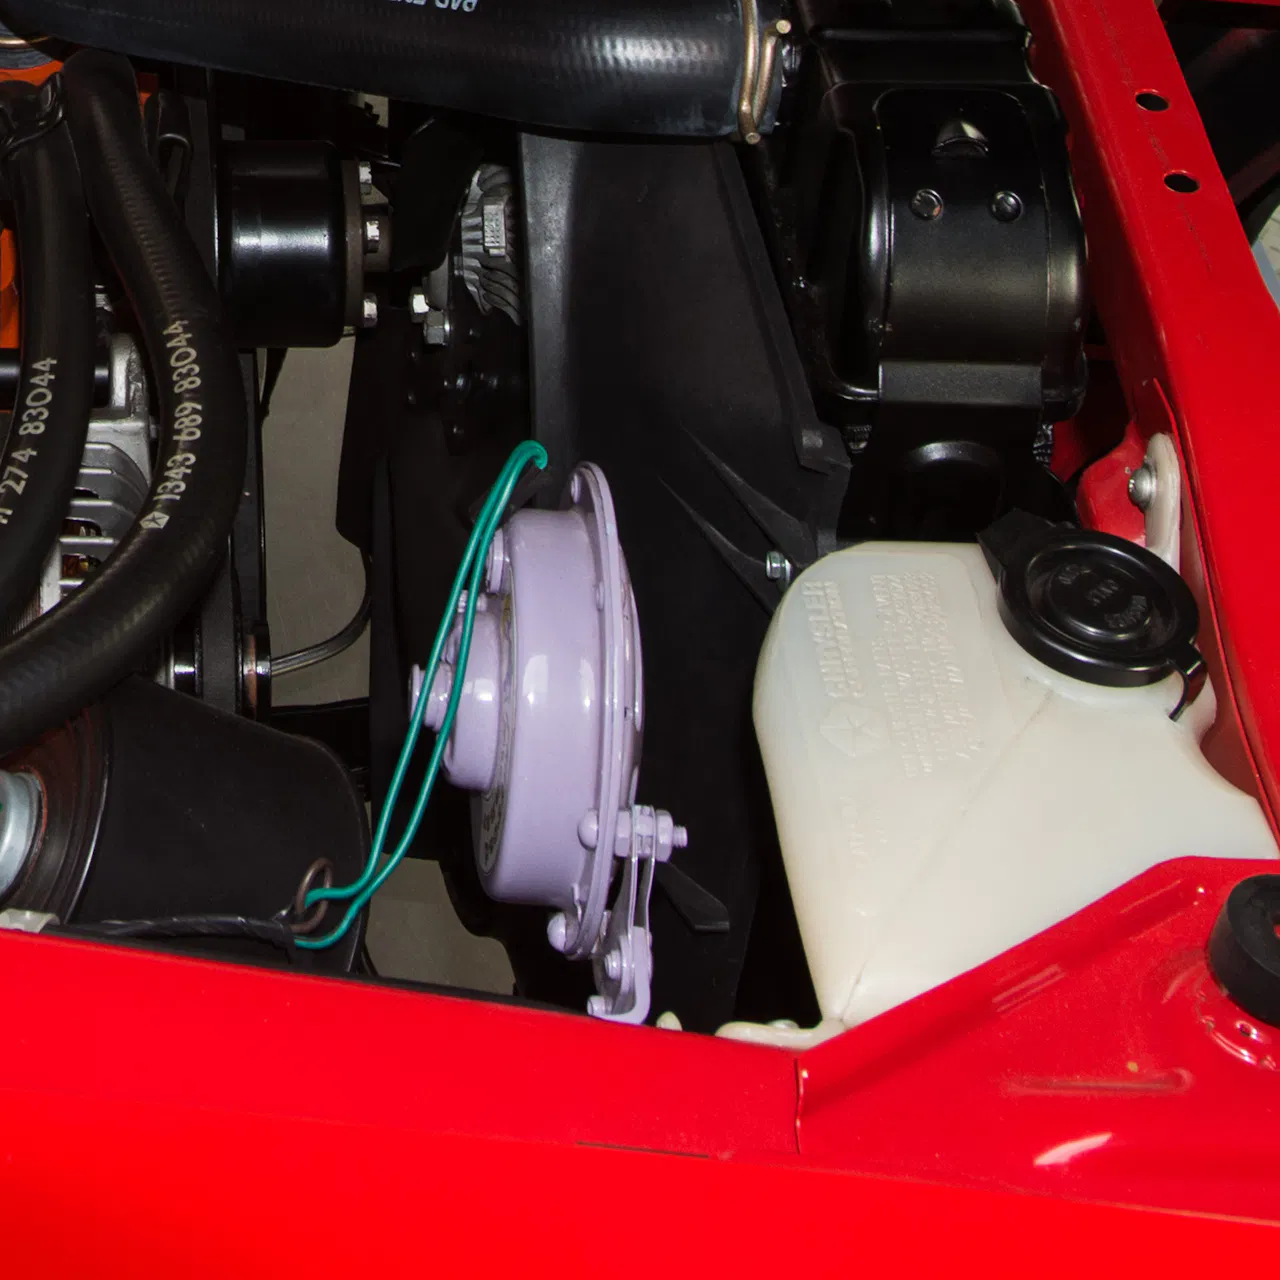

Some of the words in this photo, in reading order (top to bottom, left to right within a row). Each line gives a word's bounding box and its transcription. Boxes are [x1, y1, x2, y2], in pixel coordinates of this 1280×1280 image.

[162, 319, 202, 395] 83044
[18, 356, 58, 437] 83044
[172, 398, 203, 444] 689
[153, 451, 197, 502] 1343
